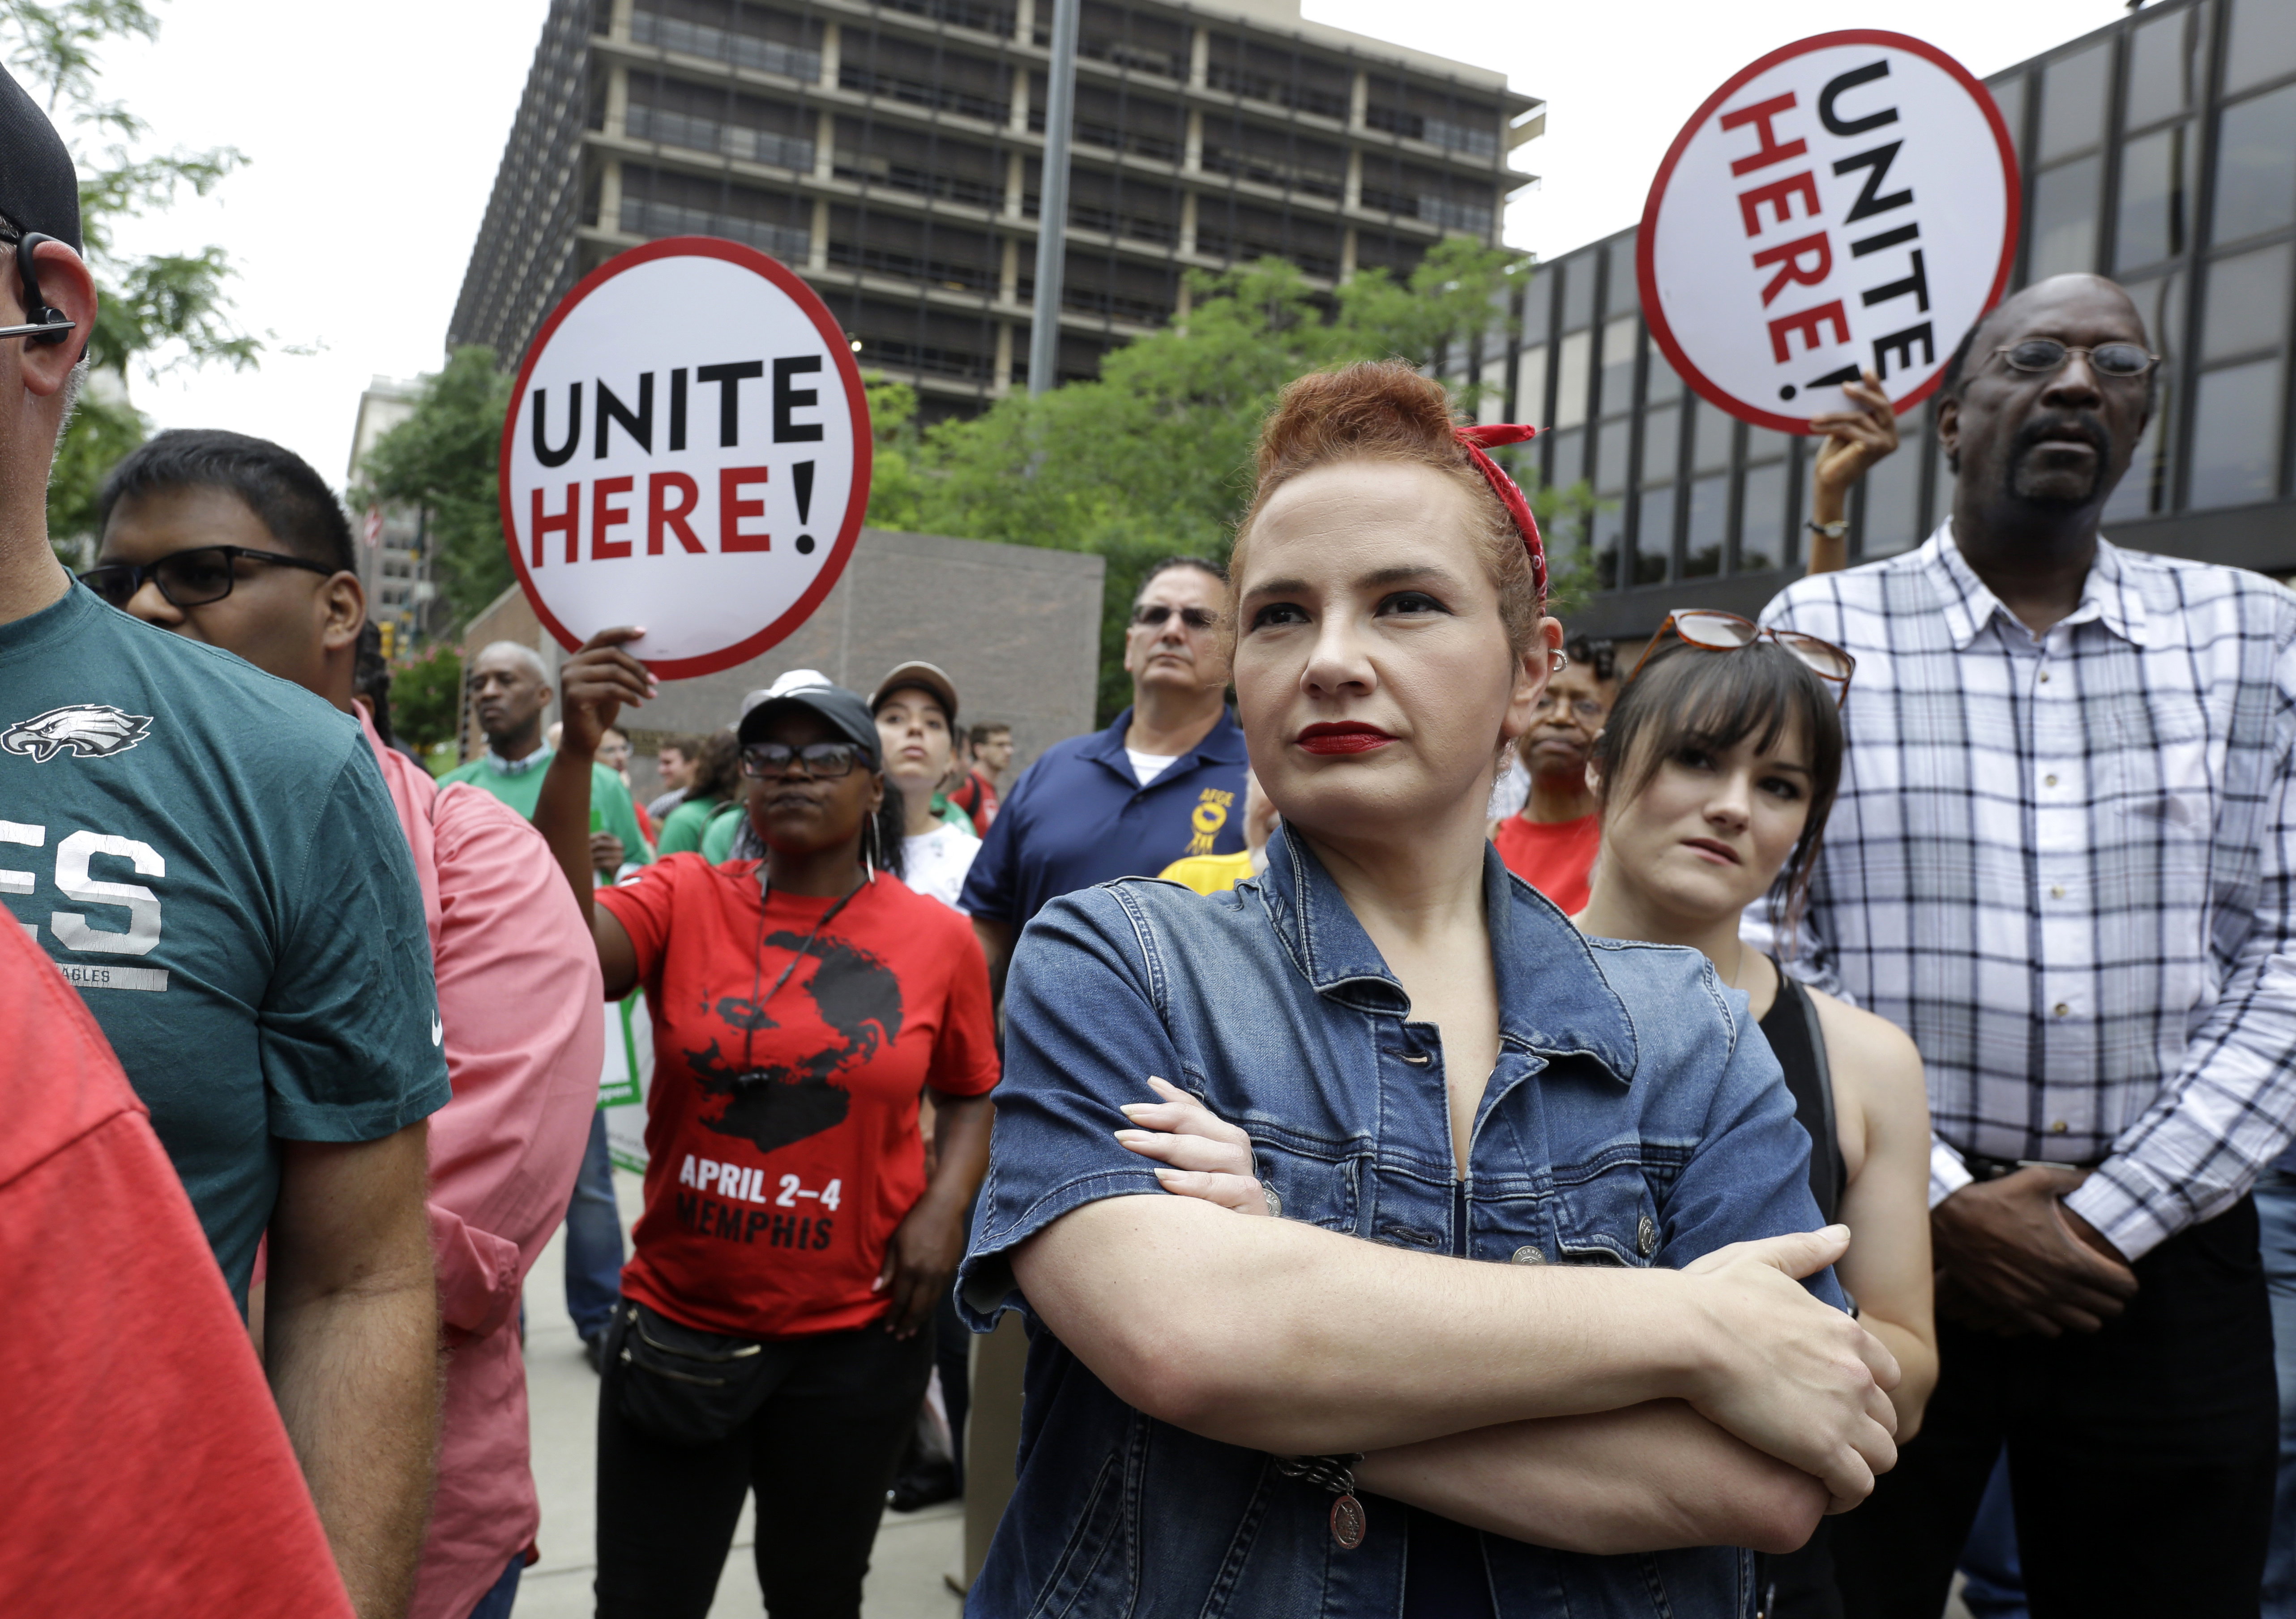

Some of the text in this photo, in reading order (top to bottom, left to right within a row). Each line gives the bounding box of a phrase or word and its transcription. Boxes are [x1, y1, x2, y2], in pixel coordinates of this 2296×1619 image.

[1718, 91, 1864, 402] HERE!
[1818, 59, 1935, 382] UNITE
[532, 355, 823, 468] UNITE
[531, 459, 815, 568] HERE!
[62, 967, 110, 983] AGLES
[676, 1191, 834, 1251] MEMPHIS
[679, 1154, 766, 1204] APRIL
[1518, 1248, 1542, 1259] TORRID
